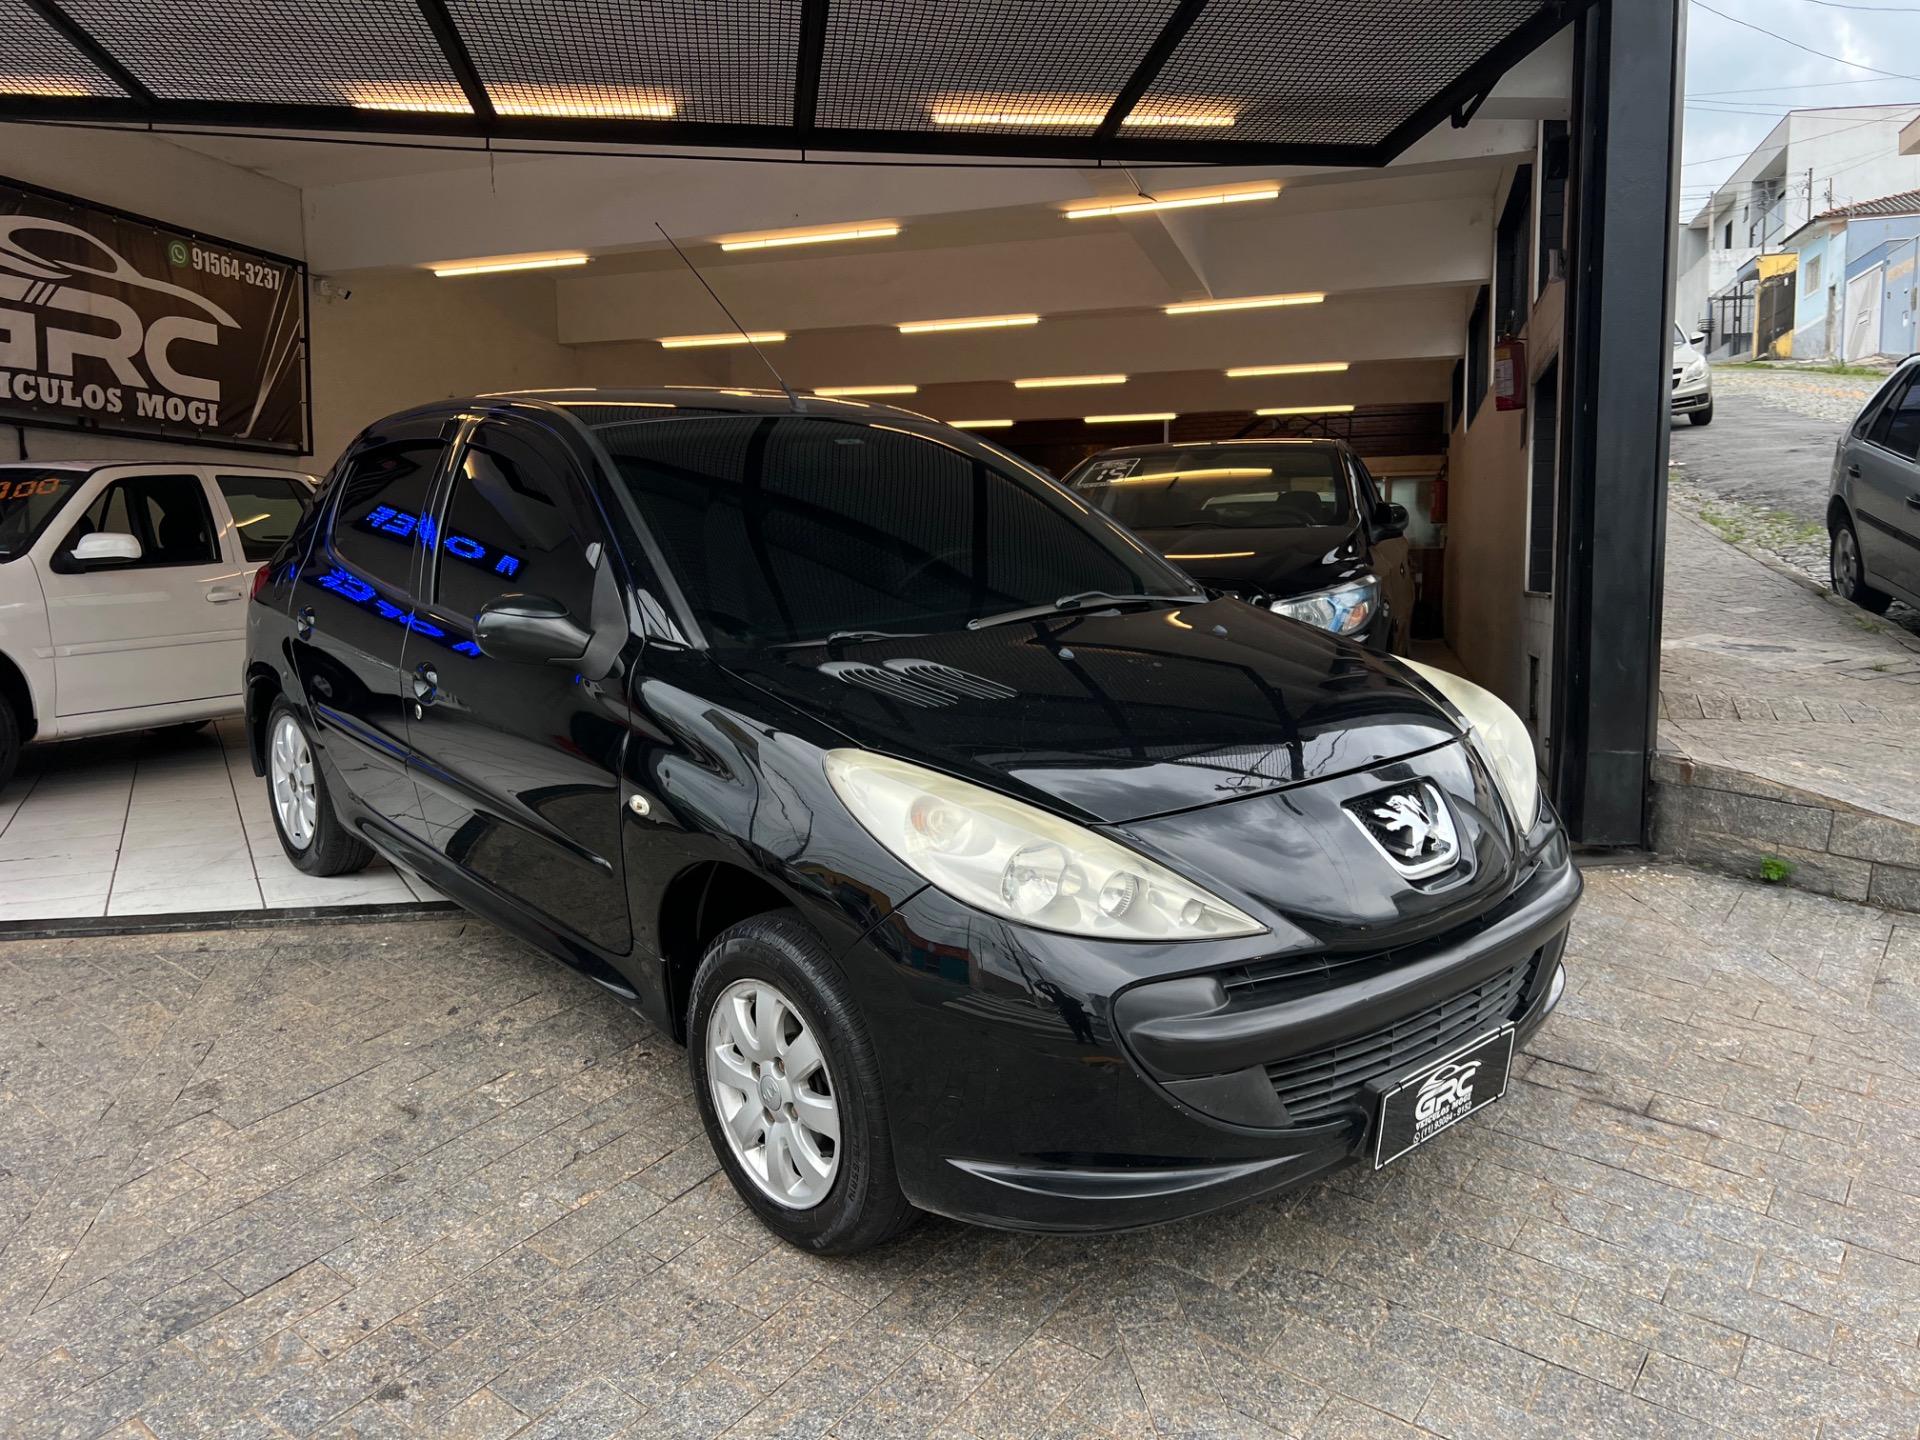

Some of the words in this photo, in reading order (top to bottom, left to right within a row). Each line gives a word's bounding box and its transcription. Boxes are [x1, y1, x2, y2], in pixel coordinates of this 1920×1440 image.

[192, 247, 280, 290] 91564-3237
[136, 391, 219, 427] MOGI
[1415, 1067, 1476, 1121] GRC
